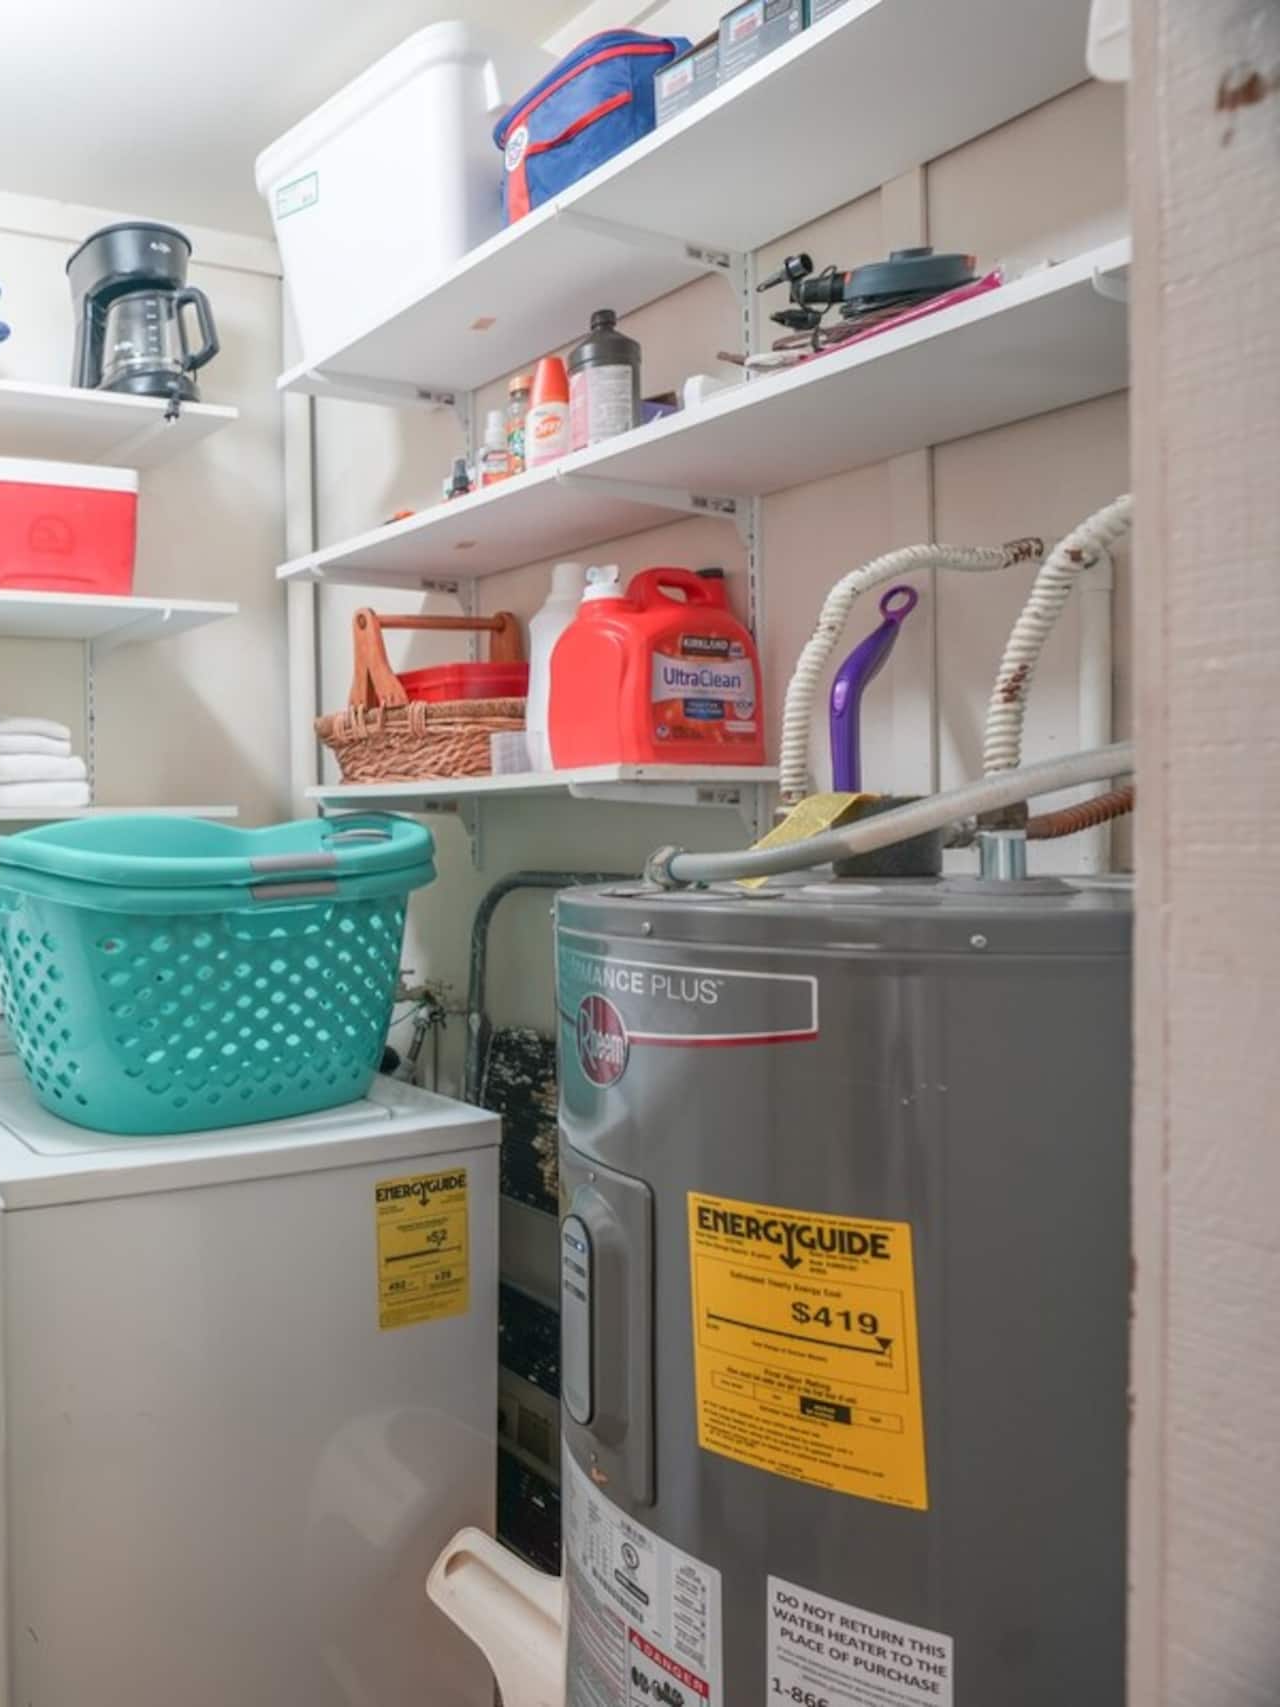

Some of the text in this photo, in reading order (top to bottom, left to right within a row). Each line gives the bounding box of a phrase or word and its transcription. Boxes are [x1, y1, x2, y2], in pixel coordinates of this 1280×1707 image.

[684, 638, 729, 650] KIRKLAND
[662, 666, 741, 688] UltraClean
[376, 1174, 466, 1202] ENERGYGUIDE
[697, 1205, 891, 1260] ENERGYGUIDE
[791, 1301, 879, 1336] $419
[772, 1605, 825, 1637] WATER
[828, 1628, 886, 1660] HEATER
[890, 1651, 913, 1667] TO
[916, 1657, 948, 1679] THE
[776, 1591, 947, 1659] DO NOT RETURN THIS
[644, 1645, 705, 1694] DANGER
[780, 1626, 825, 1656] PLACE
[829, 1647, 850, 1663] OF
[853, 1655, 940, 1695] PURCHASE
